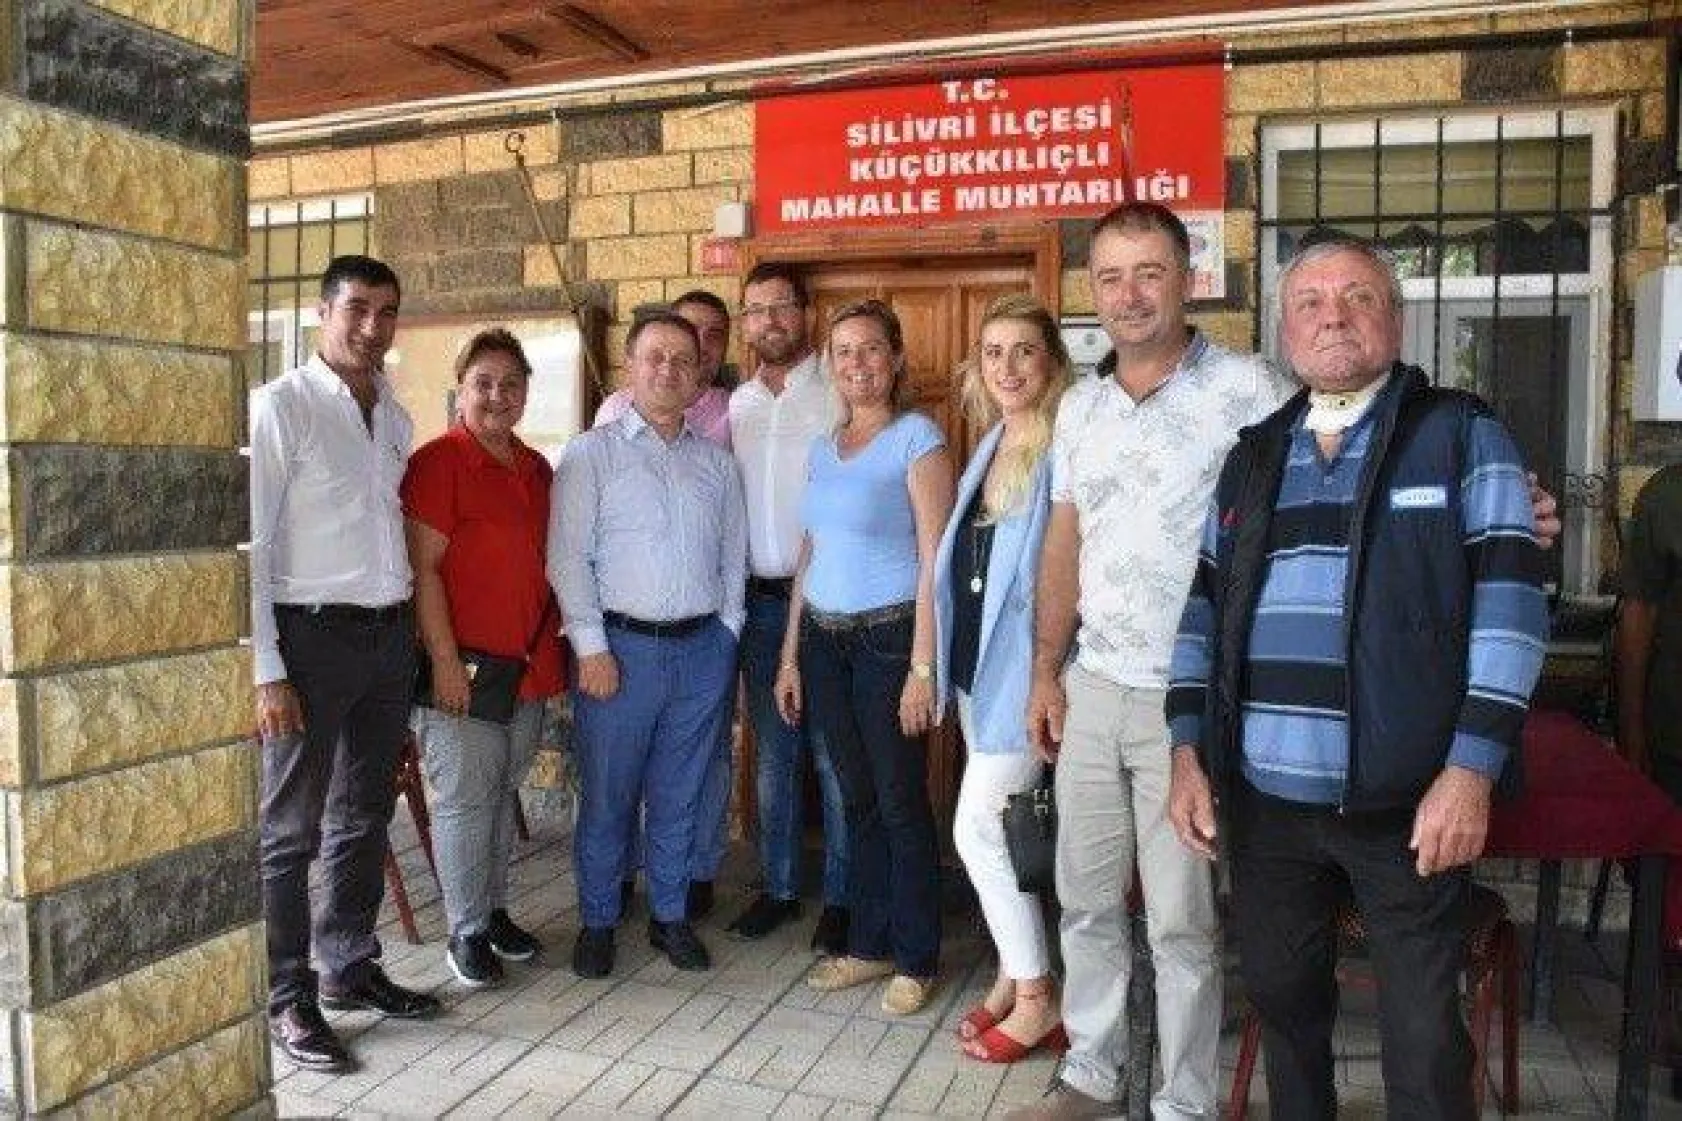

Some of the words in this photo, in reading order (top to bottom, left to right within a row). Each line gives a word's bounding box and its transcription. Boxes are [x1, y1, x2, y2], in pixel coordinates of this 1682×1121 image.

[942, 79, 1009, 104] T.C.
[847, 114, 976, 148] SİLİVRİ
[992, 99, 1111, 138] İLÇESİ
[850, 142, 1109, 184] KÜÇÜKKILIÇLI
[782, 188, 941, 221] MAHALLE
